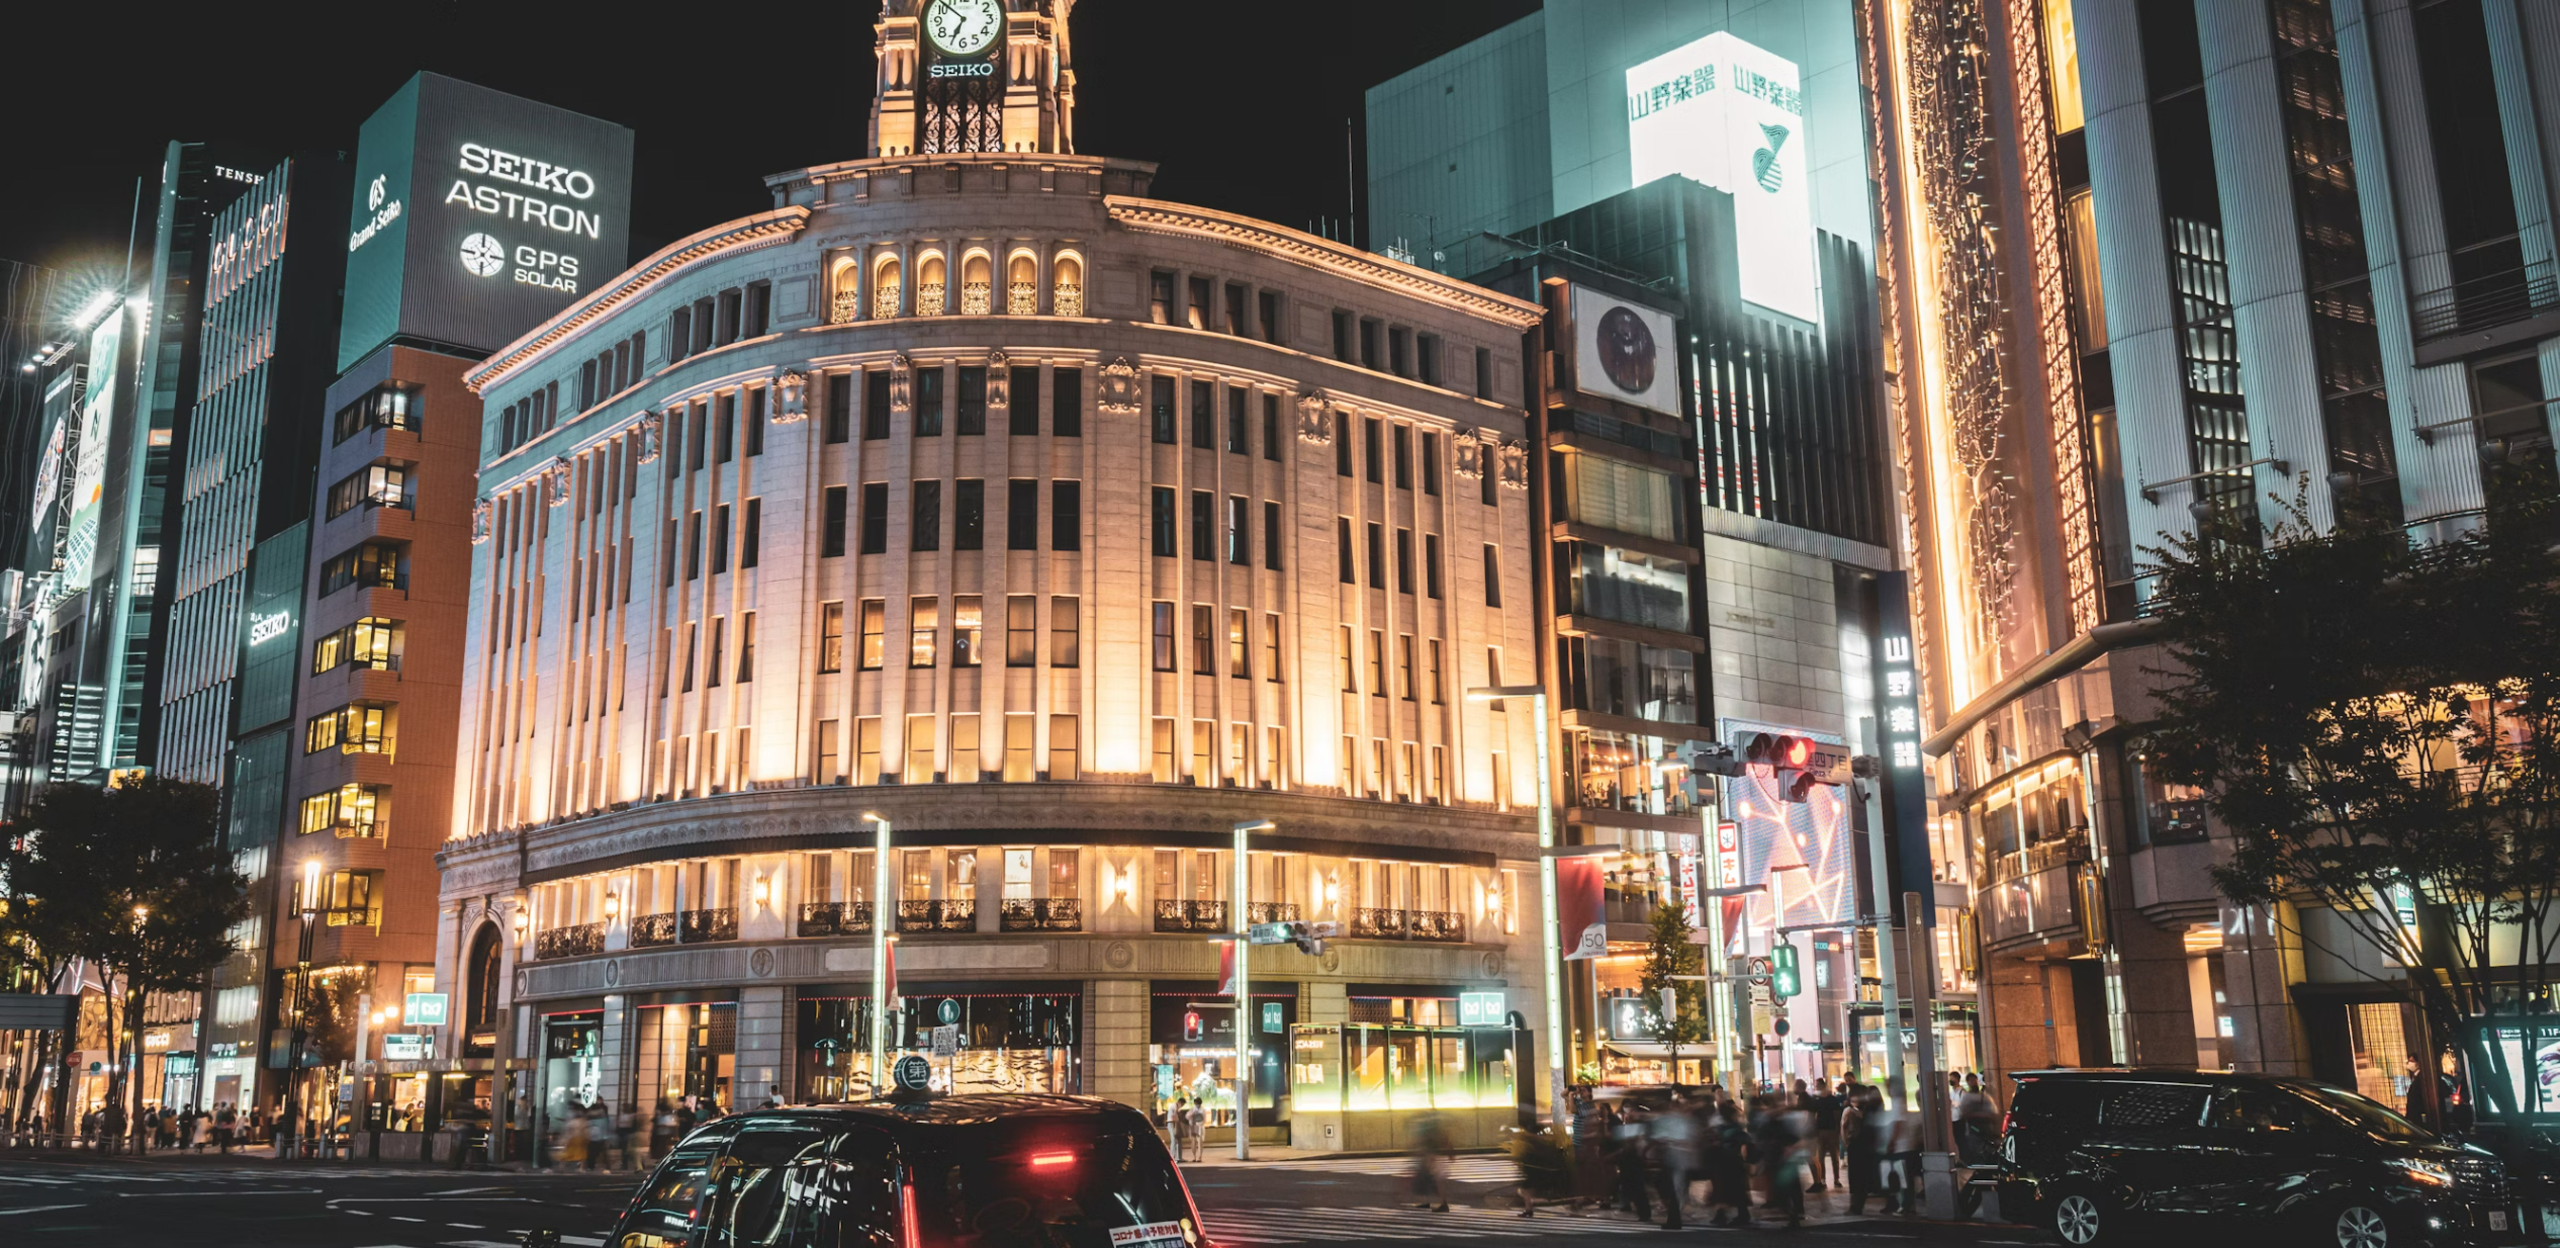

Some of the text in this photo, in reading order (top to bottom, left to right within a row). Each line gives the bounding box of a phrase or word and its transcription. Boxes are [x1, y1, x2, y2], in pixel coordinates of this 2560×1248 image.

[982, 2, 989, 13] 2
[934, 16, 943, 27] 9
[985, 14, 994, 25] 3
[938, 27, 947, 38] 8
[980, 26, 990, 36] 4
[959, 38, 967, 48] 6
[971, 34, 979, 45] 5
[931, 63, 993, 77] SEIKO
[1630, 63, 1715, 121] 山野楽器
[1733, 63, 1802, 117] 山野楽器
[460, 143, 594, 199] SEIKO
[445, 180, 600, 239] ASTRON
[350, 199, 401, 252] Grand Seiko
[516, 246, 579, 277] GPS
[515, 269, 577, 293] SOLAR
[250, 610, 289, 647] SEIKO
[1884, 636, 1918, 767] 山野楽器
[1581, 933, 1605, 948] 150
[145, 1033, 169, 1047] GUCCI
